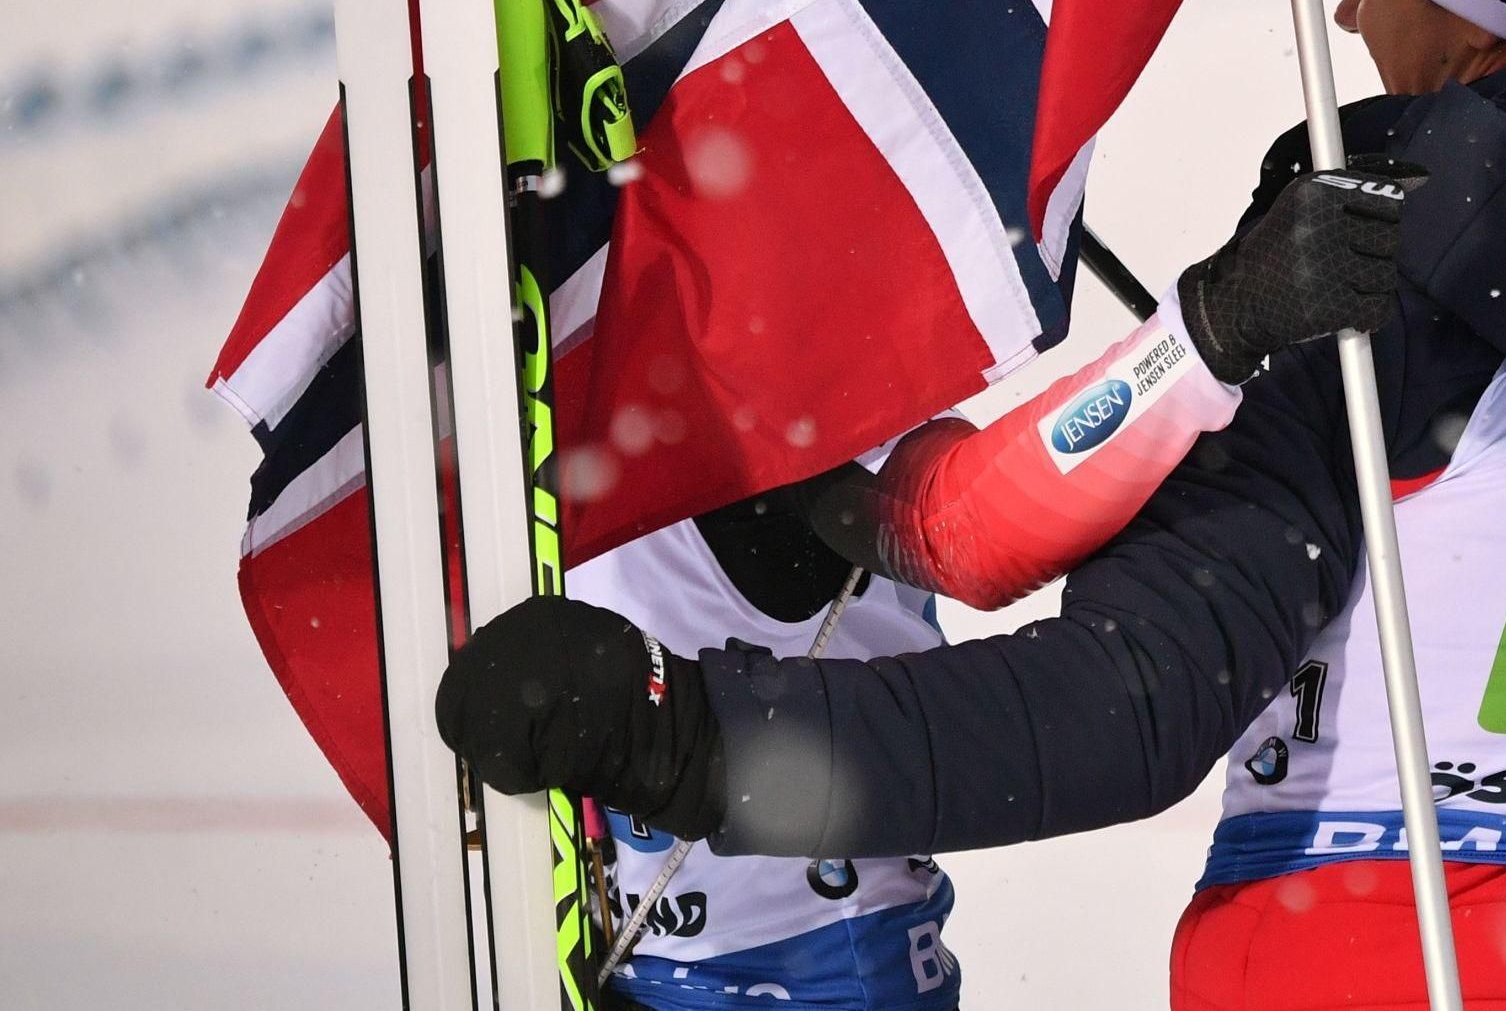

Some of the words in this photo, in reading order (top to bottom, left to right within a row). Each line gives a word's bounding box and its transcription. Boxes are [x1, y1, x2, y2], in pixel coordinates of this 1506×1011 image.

[1133, 340, 1169, 379] POWERED
[1136, 362, 1166, 397] JENSEN
[1061, 387, 1125, 451] JENSEN
[1289, 659, 1329, 743] 1
